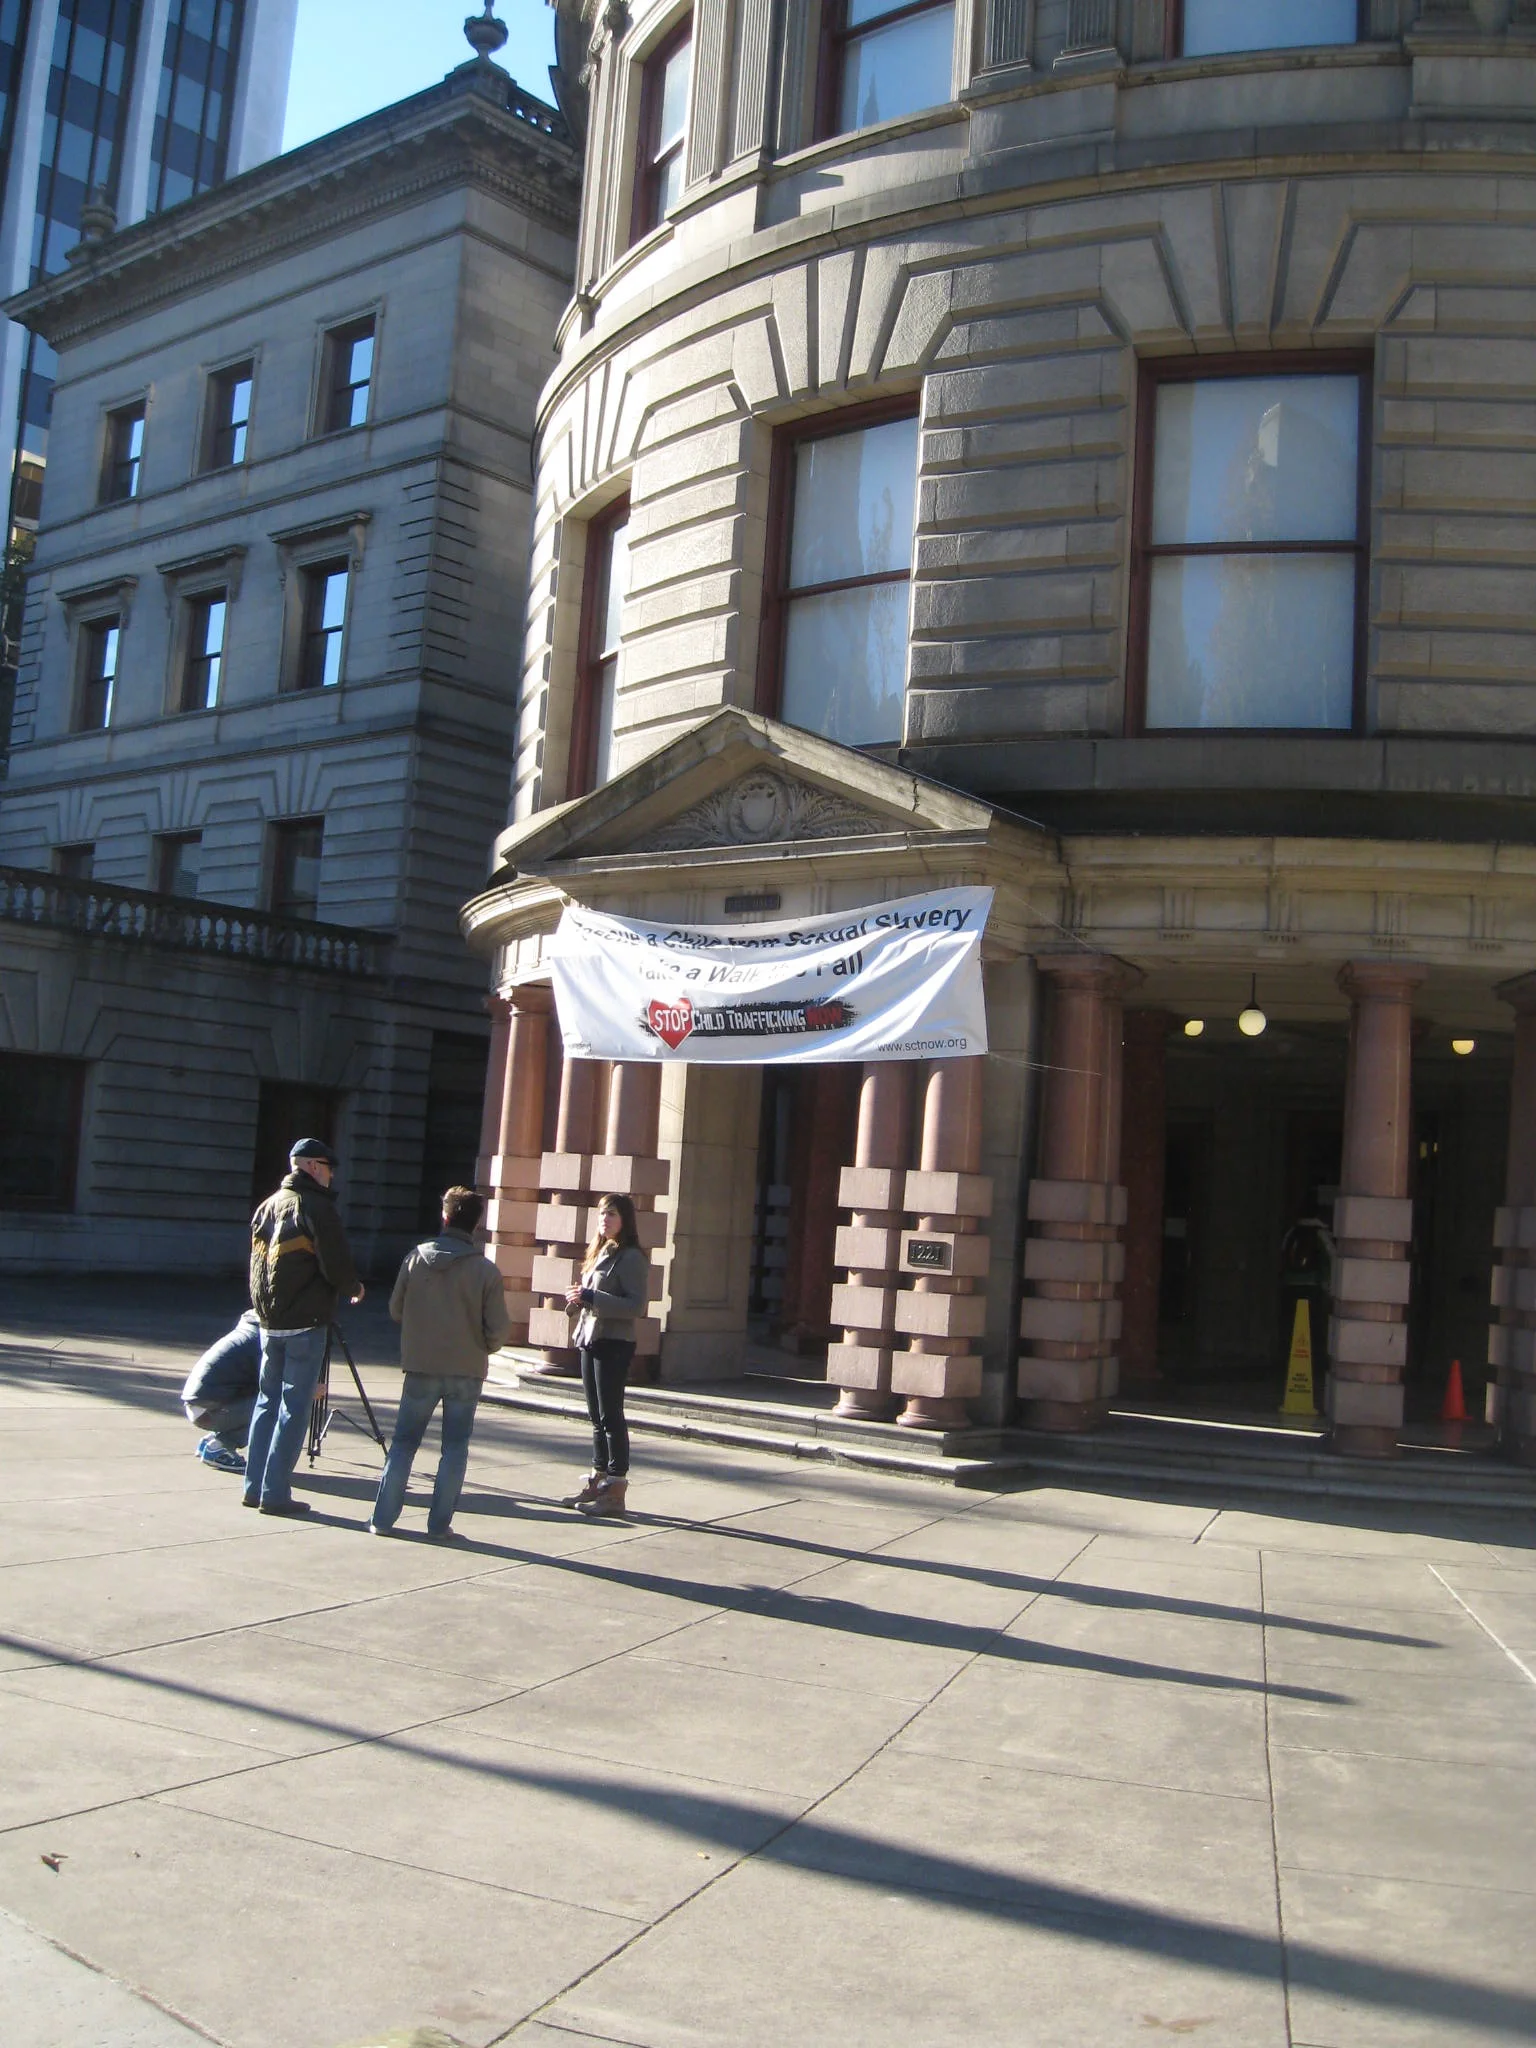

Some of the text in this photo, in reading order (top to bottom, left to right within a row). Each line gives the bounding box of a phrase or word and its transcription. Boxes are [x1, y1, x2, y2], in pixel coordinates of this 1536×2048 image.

[685, 967, 701, 981] a
[654, 1009, 689, 1032] STOP
[691, 1010, 724, 1031] CHILD
[725, 1008, 806, 1031] TRAFFICKING
[877, 1038, 967, 1053] www.sctnow.org
